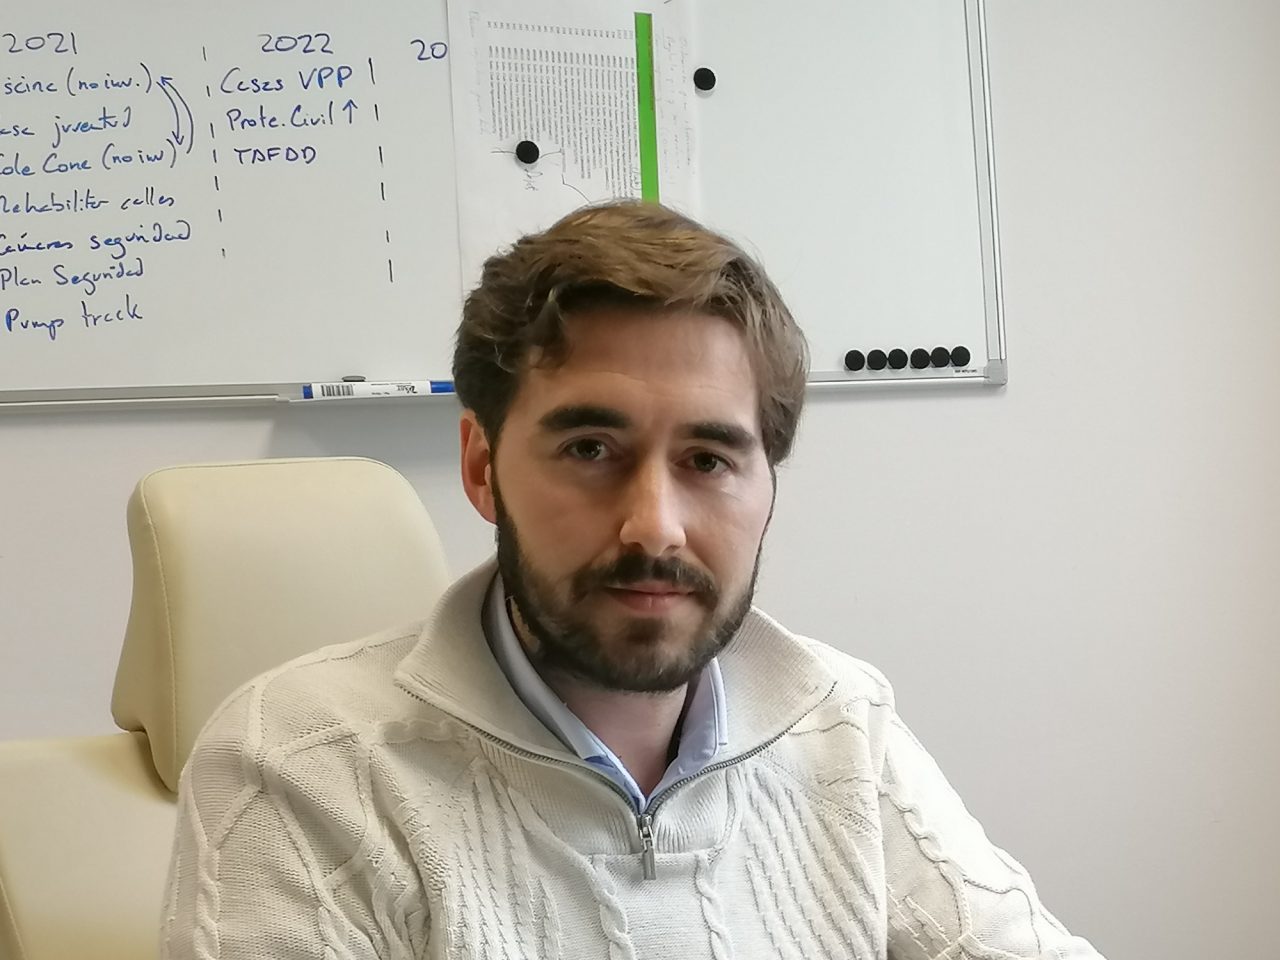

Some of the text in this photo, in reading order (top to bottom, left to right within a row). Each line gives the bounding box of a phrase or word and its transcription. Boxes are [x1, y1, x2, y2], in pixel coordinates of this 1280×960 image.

[2, 31, 78, 55] 2021
[257, 33, 334, 55] 2022
[298, 65, 353, 90] VPP
